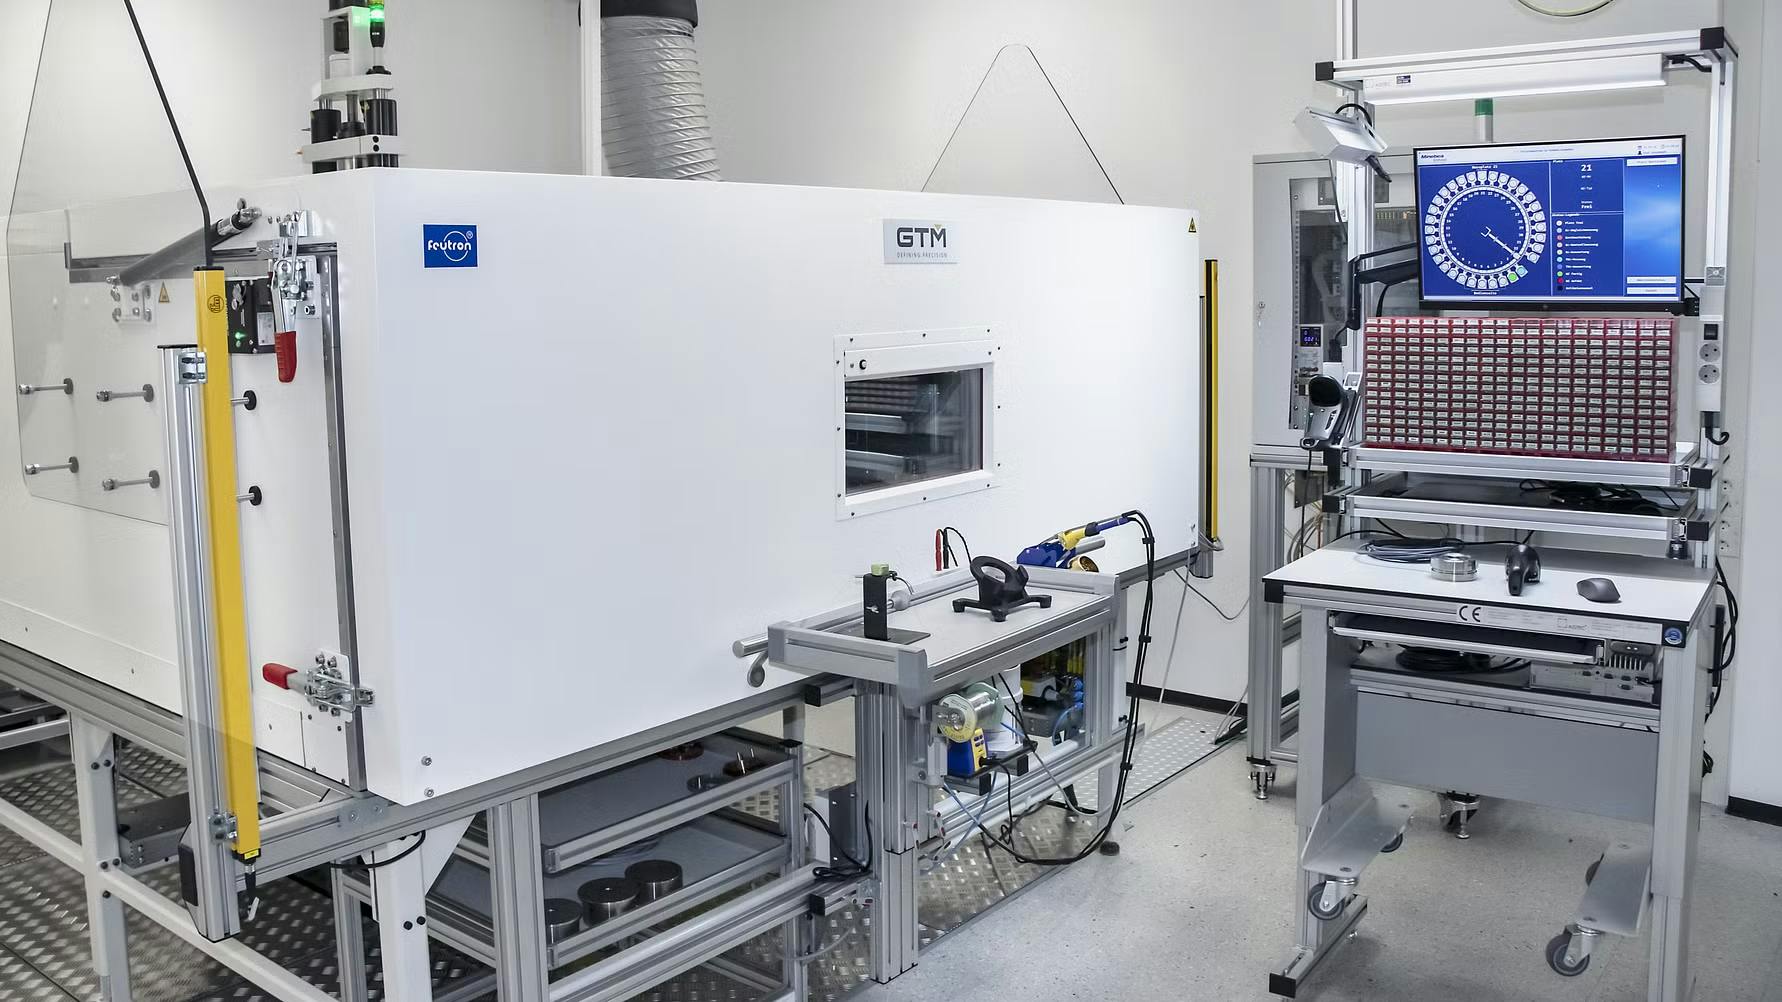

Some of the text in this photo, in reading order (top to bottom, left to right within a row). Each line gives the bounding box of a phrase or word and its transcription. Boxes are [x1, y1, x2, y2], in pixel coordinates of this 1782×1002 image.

[1580, 164, 1592, 172] 21
[896, 227, 947, 248] GTM
[1458, 604, 1482, 623] CE
